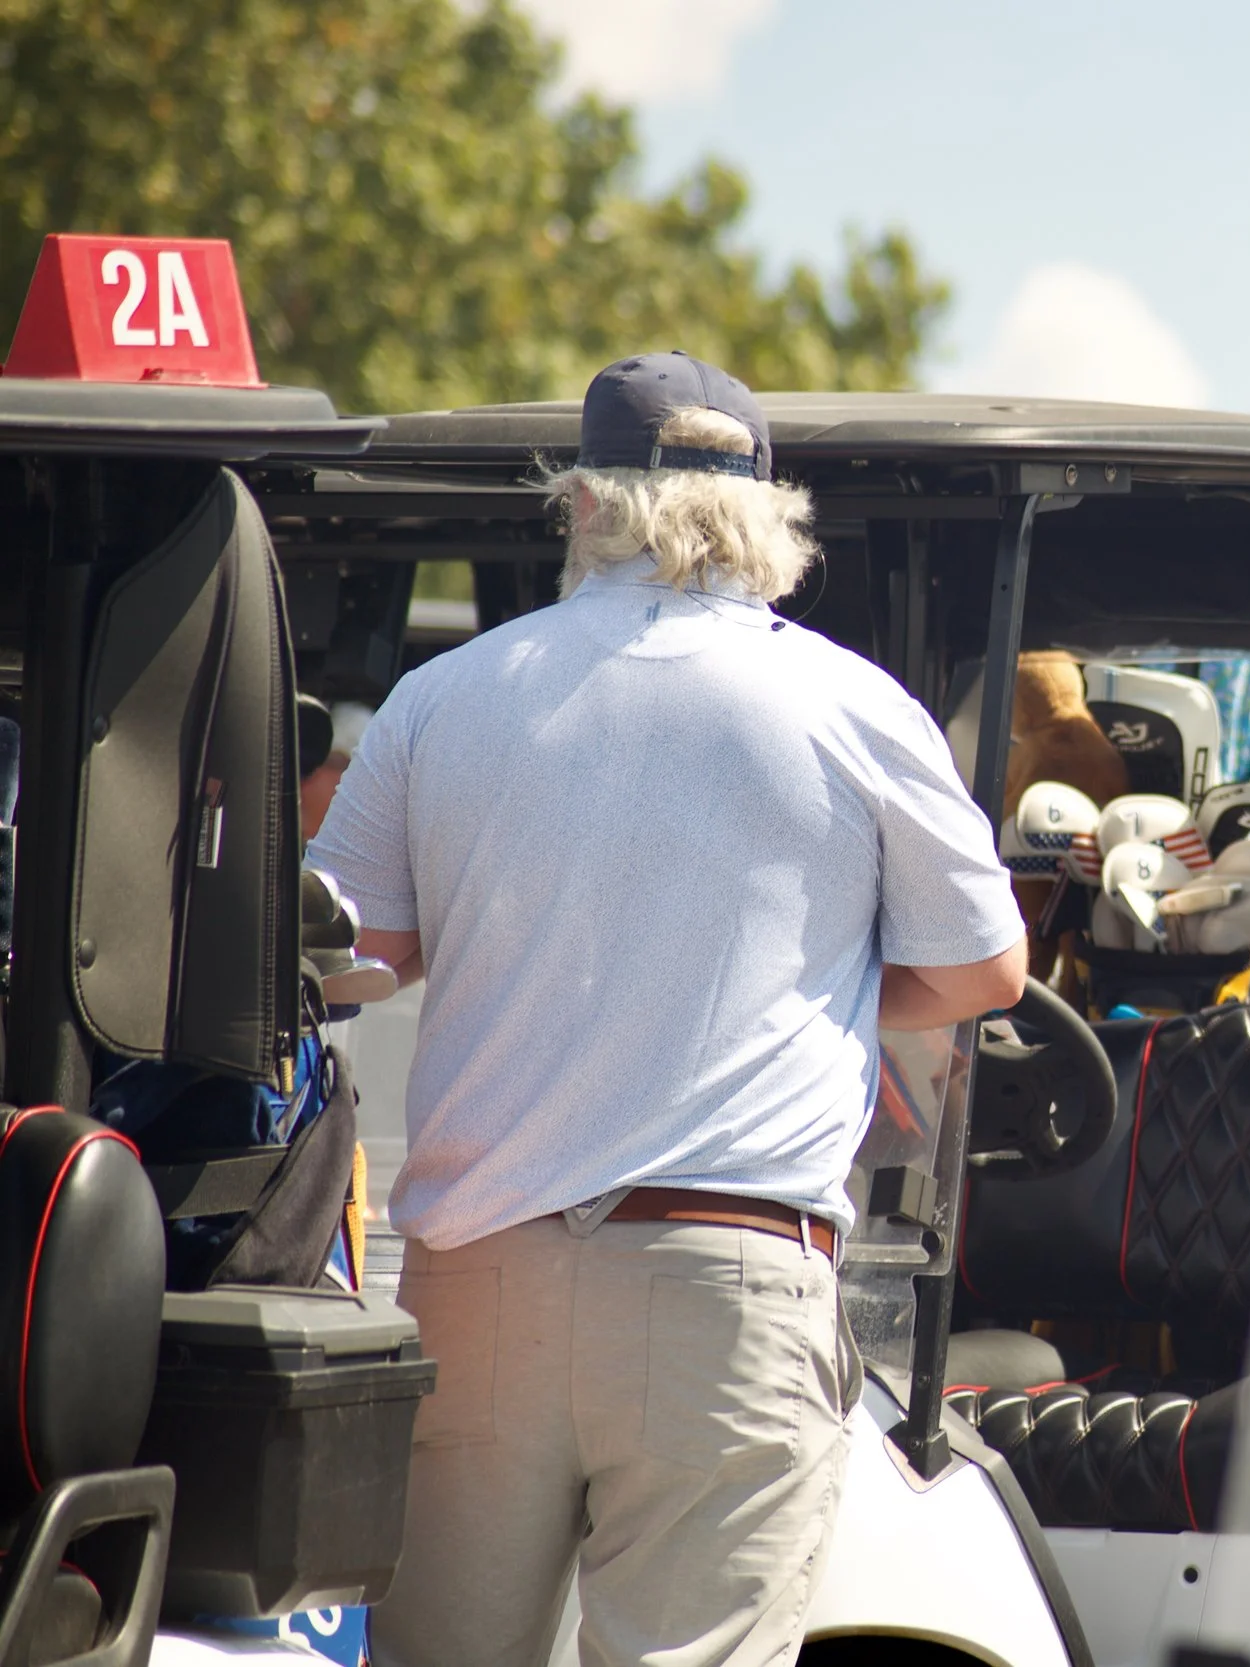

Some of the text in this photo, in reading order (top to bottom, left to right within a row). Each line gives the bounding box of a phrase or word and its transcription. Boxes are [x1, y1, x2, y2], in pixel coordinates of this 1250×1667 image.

[101, 248, 210, 347] 2A
[1047, 802, 1062, 824] 6
[1137, 858, 1152, 880] 8
